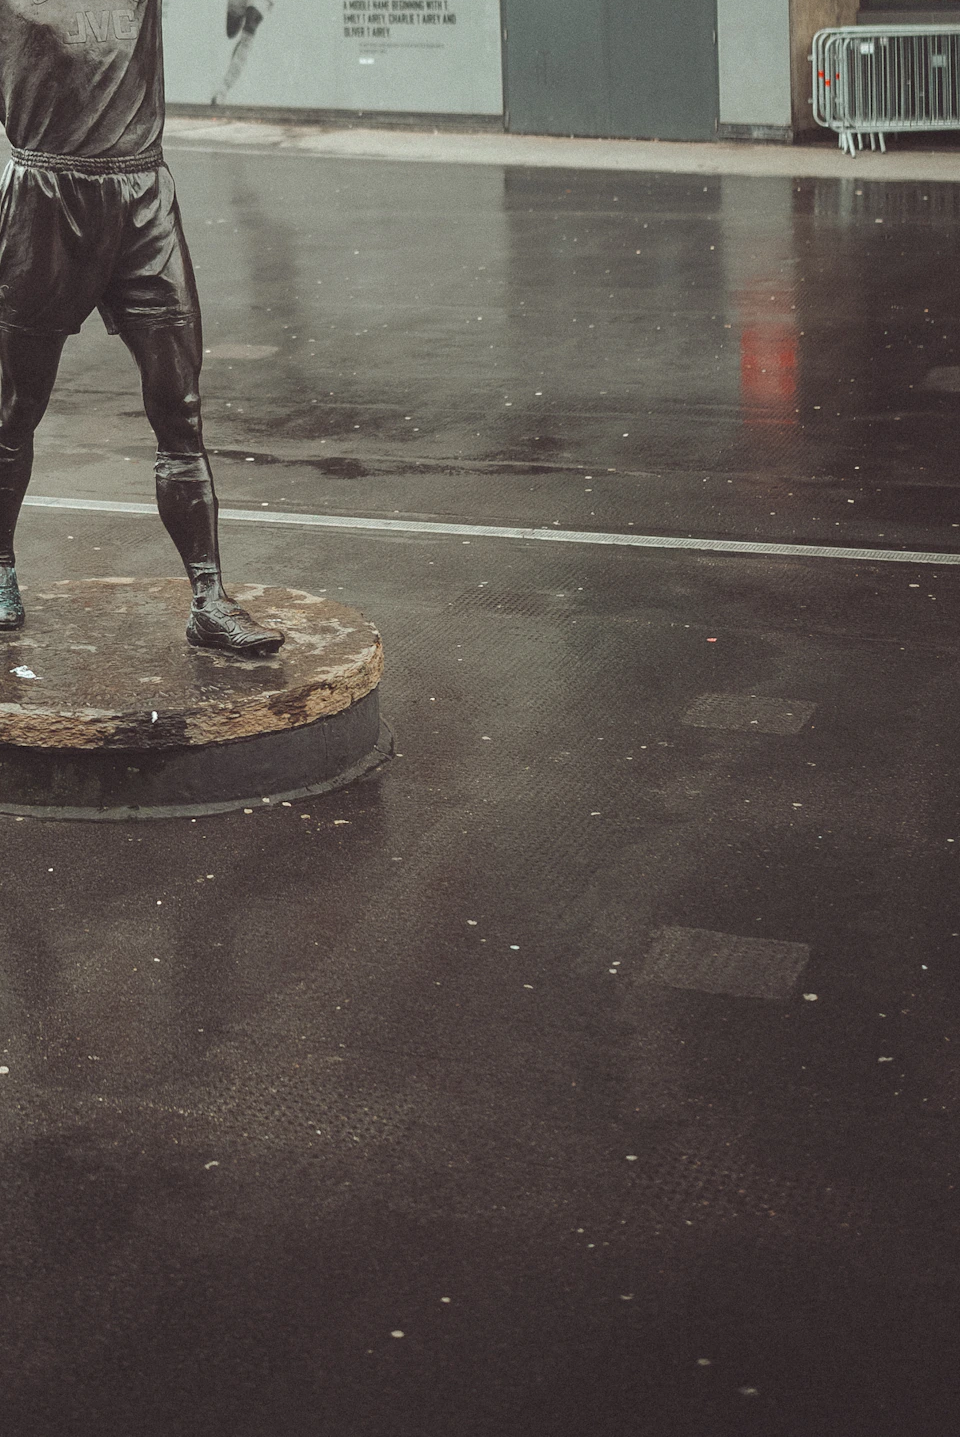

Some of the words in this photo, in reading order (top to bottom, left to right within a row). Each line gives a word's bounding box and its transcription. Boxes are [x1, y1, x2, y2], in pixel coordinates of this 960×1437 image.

[373, 0, 389, 12] NAME
[426, 0, 442, 12] WITH
[442, 13, 457, 25] AND
[62, 9, 140, 45] JVC
